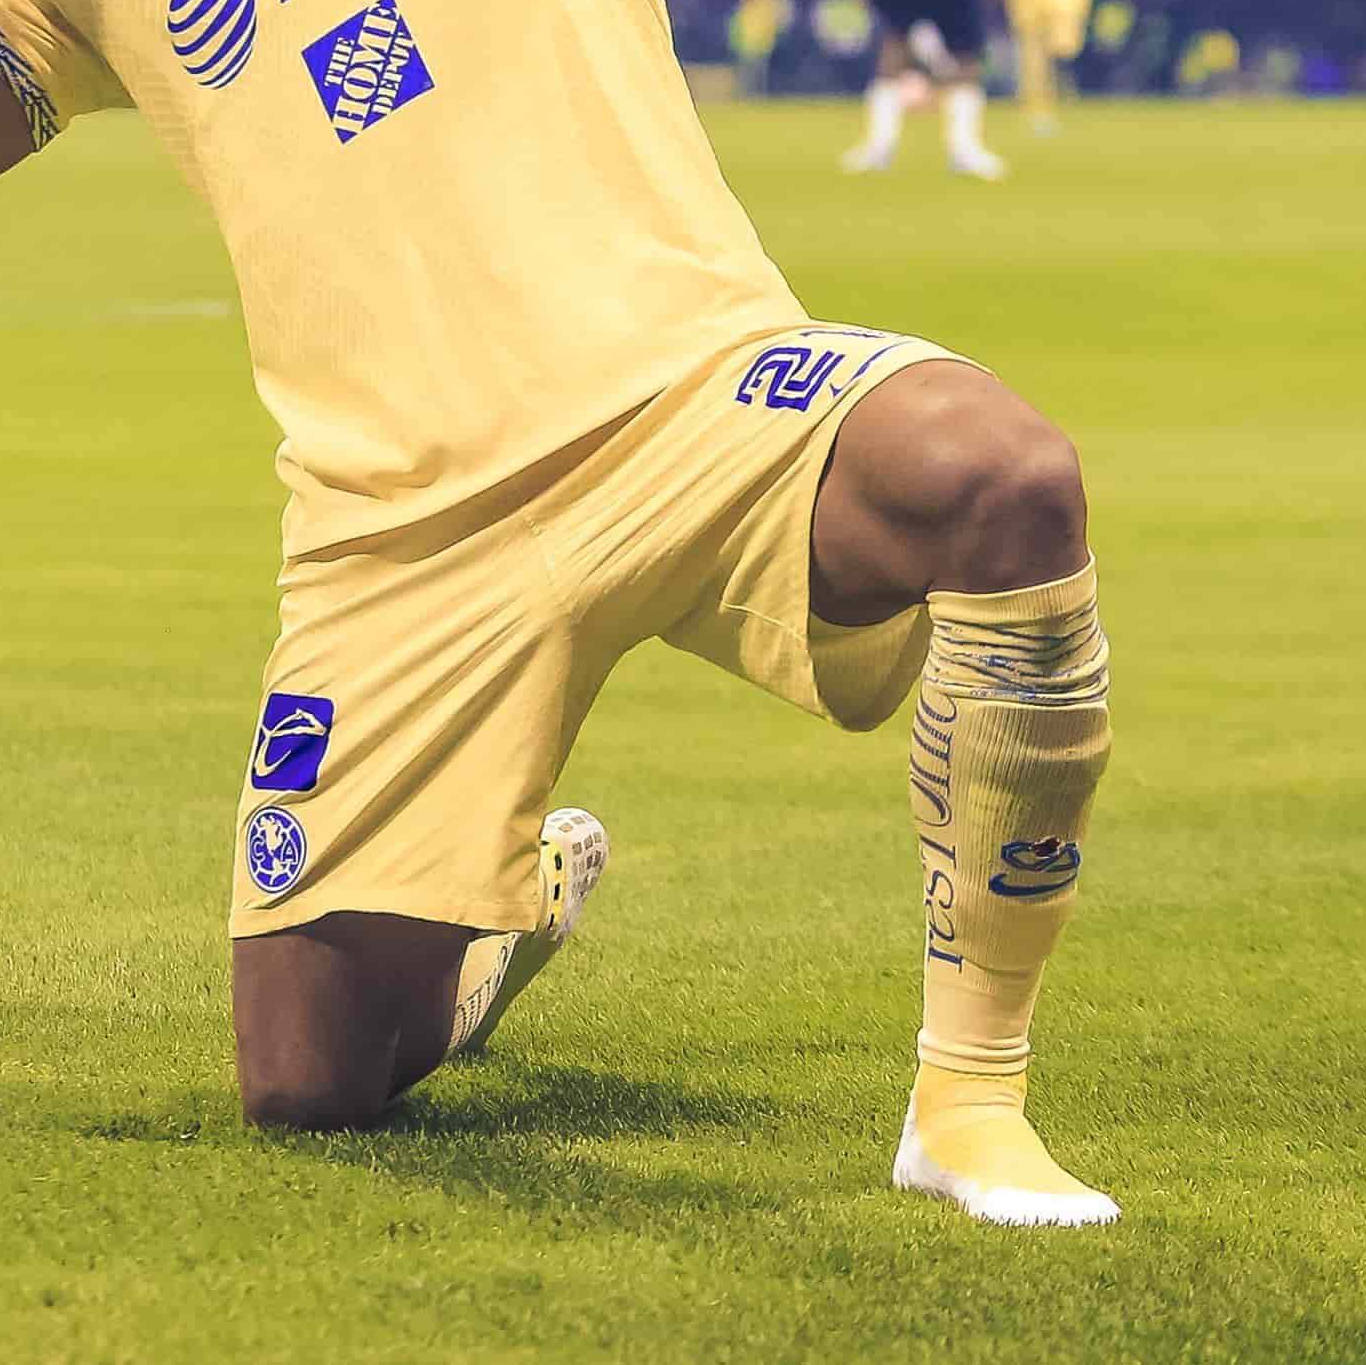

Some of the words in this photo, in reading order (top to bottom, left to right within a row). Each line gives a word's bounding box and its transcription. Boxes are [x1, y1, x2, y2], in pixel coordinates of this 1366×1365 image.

[323, 36, 355, 88] THE
[331, 3, 401, 134] HOME
[370, 31, 415, 116] DEPOT
